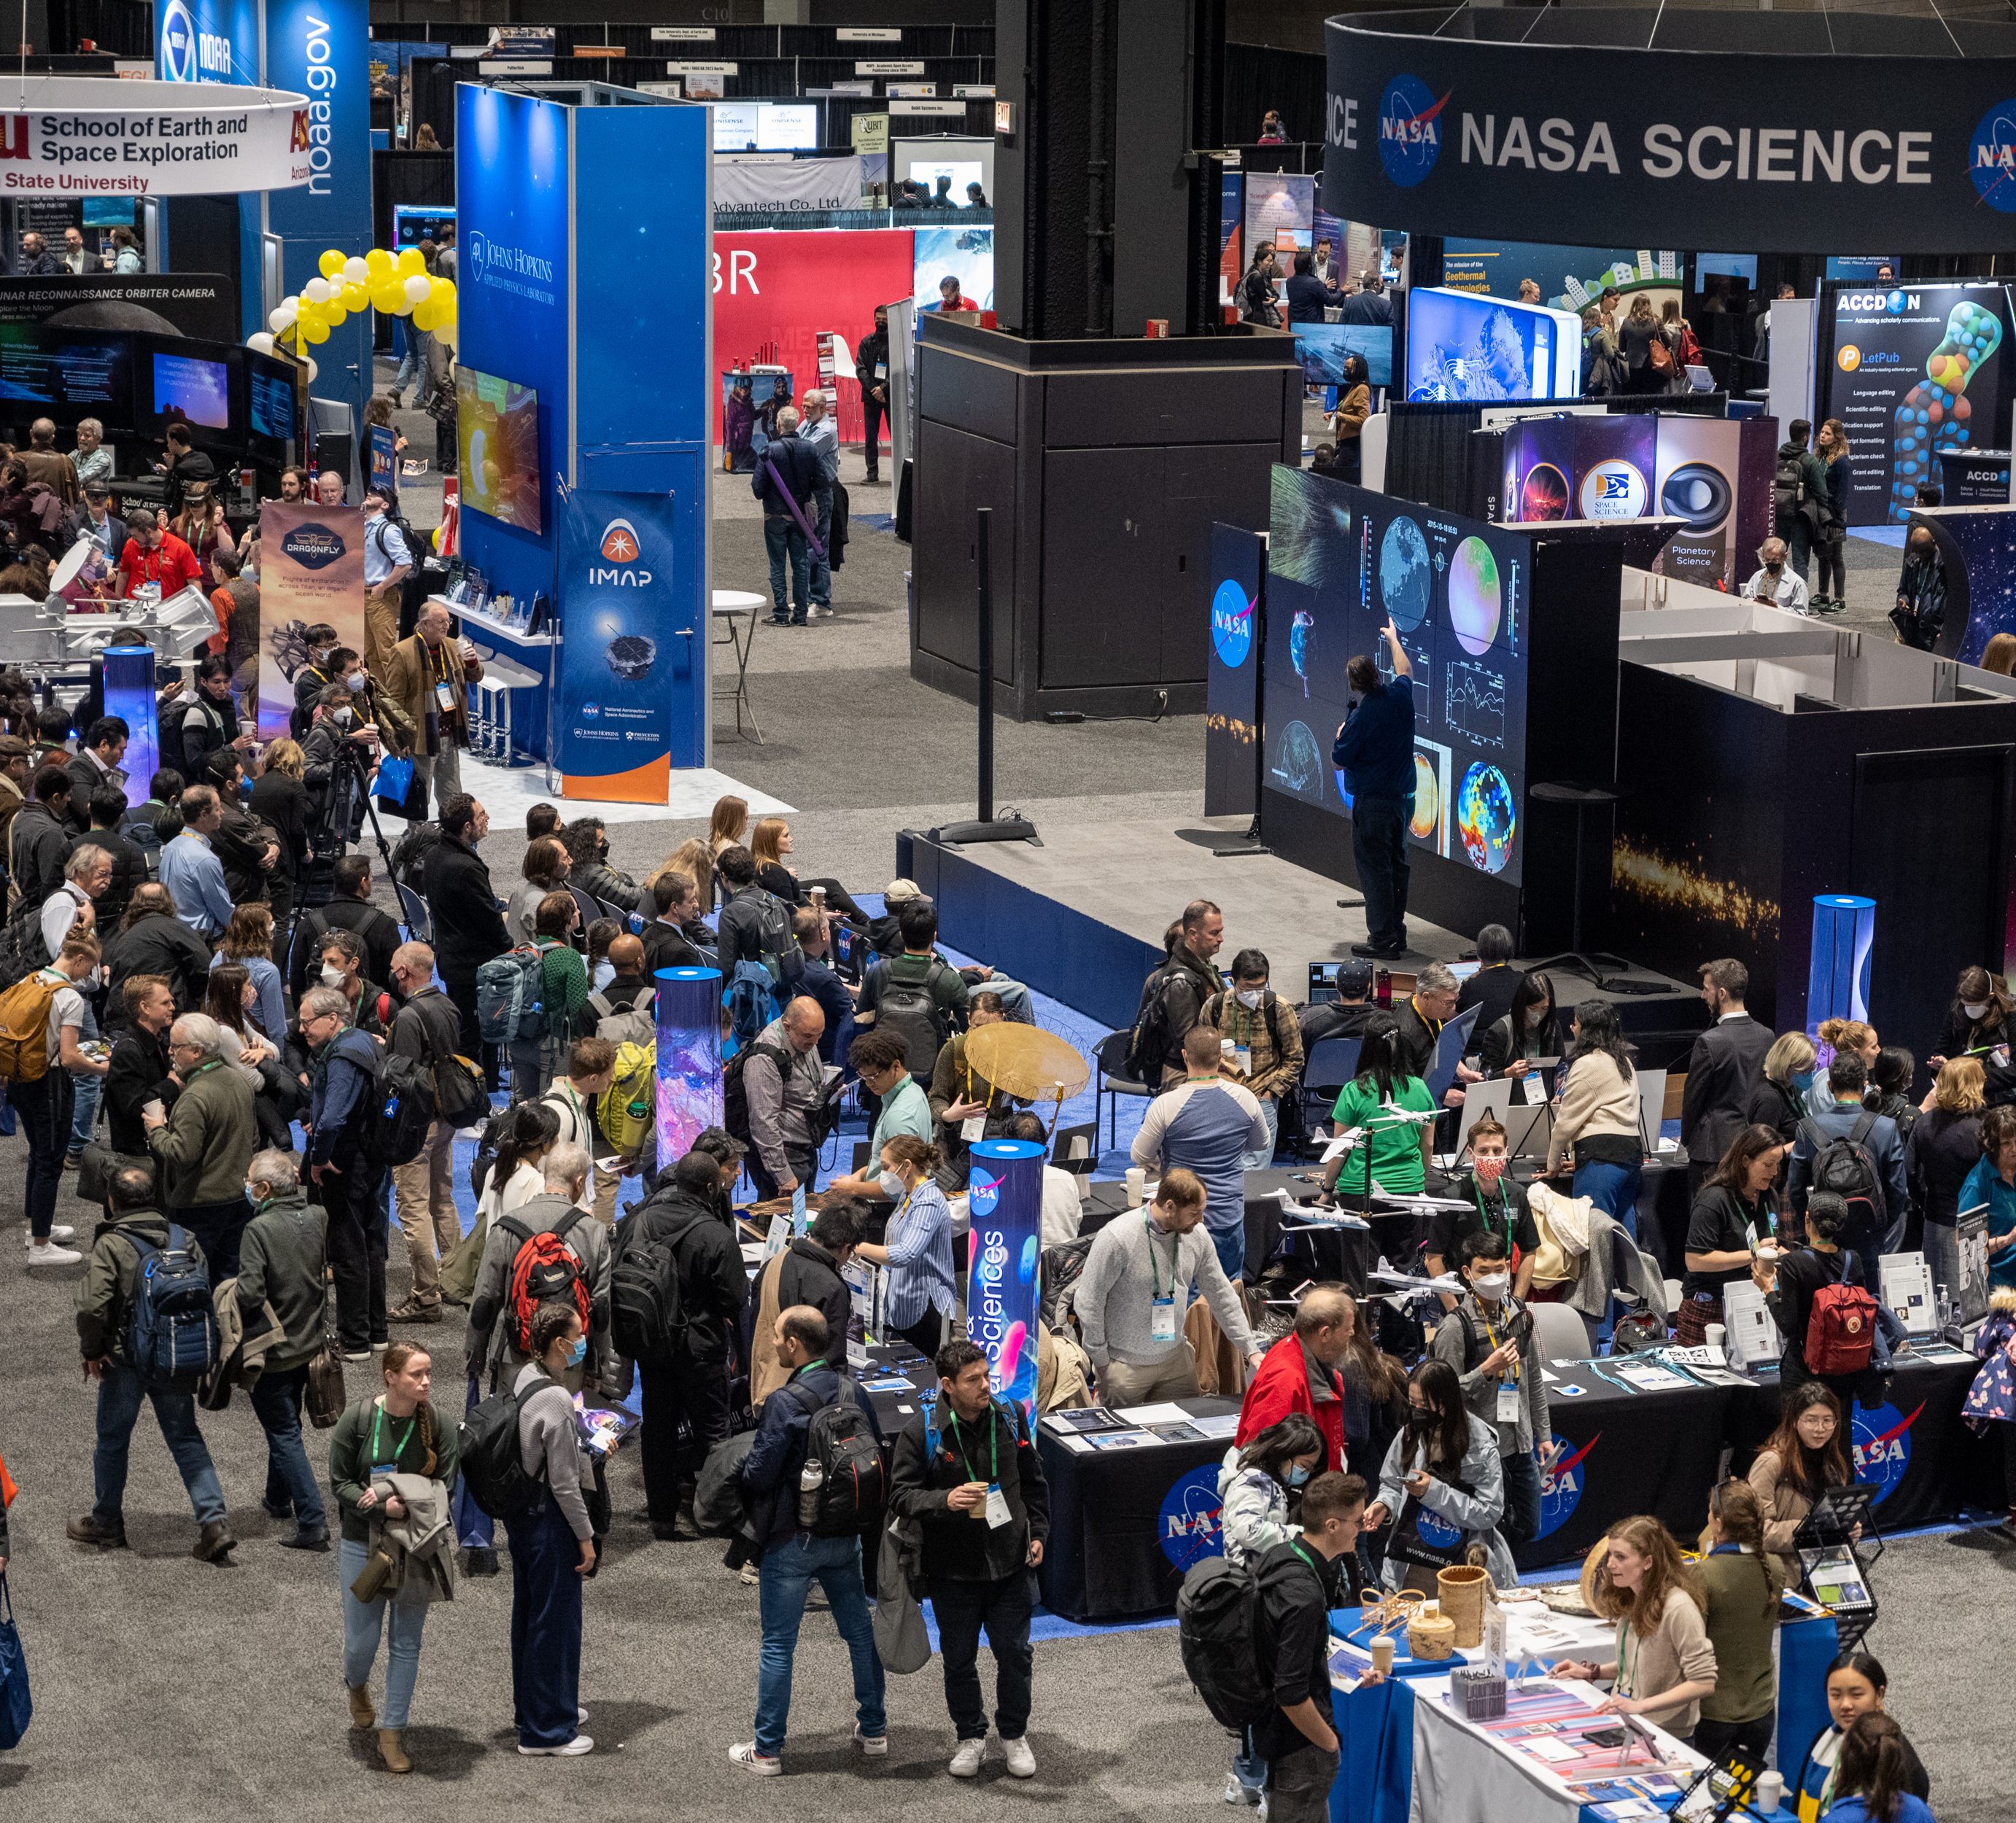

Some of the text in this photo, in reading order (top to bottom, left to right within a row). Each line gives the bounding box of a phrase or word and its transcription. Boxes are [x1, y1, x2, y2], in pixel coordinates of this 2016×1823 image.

[702, 7, 728, 20] C10
[199, 33, 230, 74] NOAA
[306, 15, 336, 195] noaa.gov
[997, 104, 1009, 124] EXIT
[41, 114, 247, 137] School of Earth and
[1381, 116, 1438, 145] NASA
[1461, 112, 1621, 174] NASA
[41, 141, 238, 166] Space Exploration
[1642, 123, 1932, 184] SCIENCE
[4, 173, 149, 193] State University
[713, 197, 842, 212] Advantech Co., Ltd.
[486, 239, 552, 283] JOHNS HOPKINS
[1445, 270, 1486, 281] Geothermal
[28, 289, 216, 300] RECONNAISSANCE ORBITER CAMERA
[484, 273, 555, 306] APPLIED PHYSICS LABORATORY
[1445, 283, 1491, 294] Technologies
[1855, 316, 1880, 324] Advancing
[1880, 316, 1901, 324] scholarly
[1862, 352, 1900, 364] LetPub
[287, 544, 340, 554] DRAGONFLY
[1672, 546, 1716, 557] Planetary
[1676, 556, 1711, 566] Science
[589, 567, 652, 587] IMAP
[1214, 610, 1249, 638] NASA
[979, 1230, 1004, 1361] Sciences
[1406, 1545, 1453, 1567] www.nasa.g
[1713, 1769, 1737, 1789] 2021
